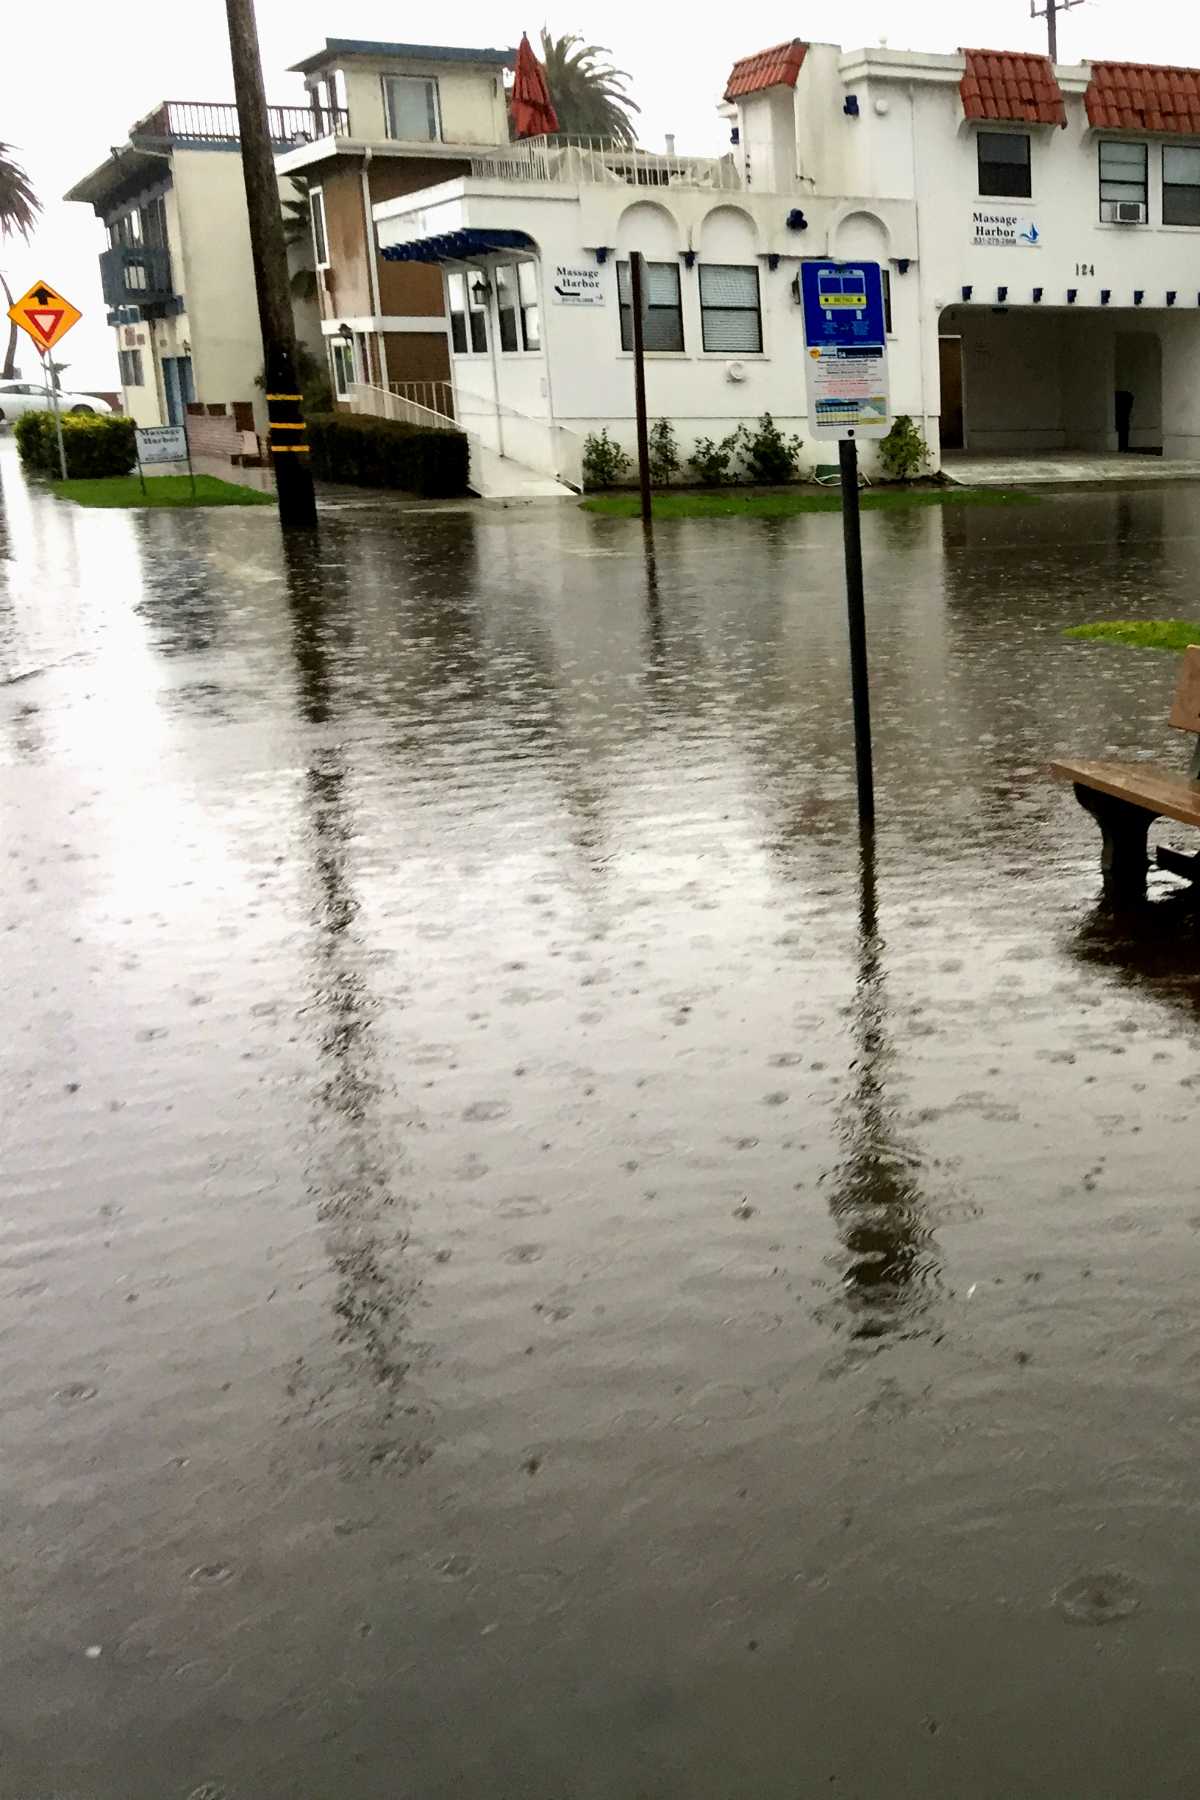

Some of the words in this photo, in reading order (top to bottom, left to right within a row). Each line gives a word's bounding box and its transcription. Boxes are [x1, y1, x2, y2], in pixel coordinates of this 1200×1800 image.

[972, 212, 1018, 226] Massage
[975, 226, 1016, 237] Harbor
[556, 266, 599, 278] Massage
[1075, 263, 1095, 276] 124
[562, 278, 600, 288] Harbor
